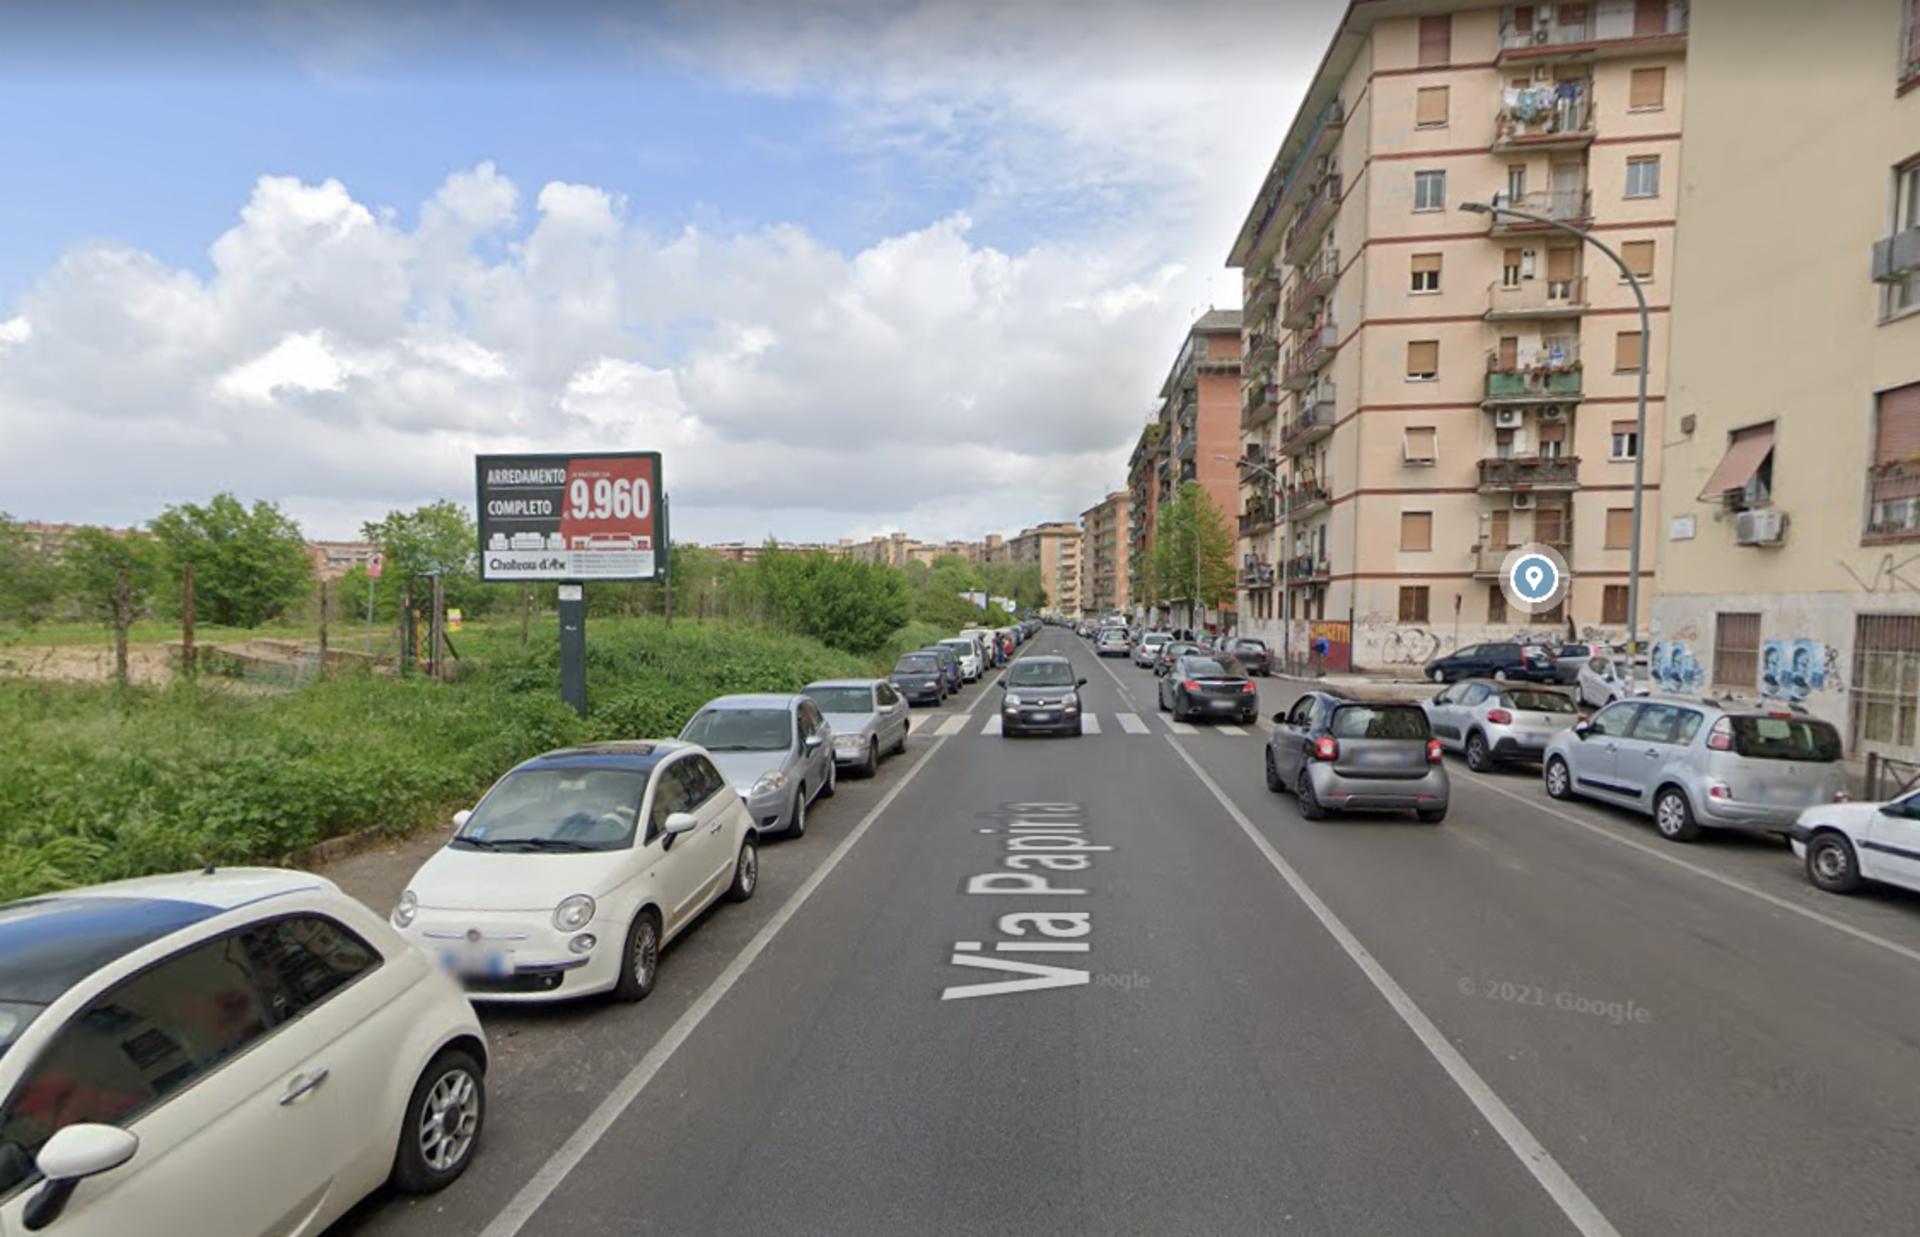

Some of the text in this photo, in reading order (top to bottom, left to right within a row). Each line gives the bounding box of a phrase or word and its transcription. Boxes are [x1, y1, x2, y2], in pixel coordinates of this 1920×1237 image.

[487, 469, 566, 484] ARREDAMENTO
[570, 478, 650, 520] 9.960
[488, 500, 552, 516] COMPLETO
[490, 558, 536, 572] Chateau
